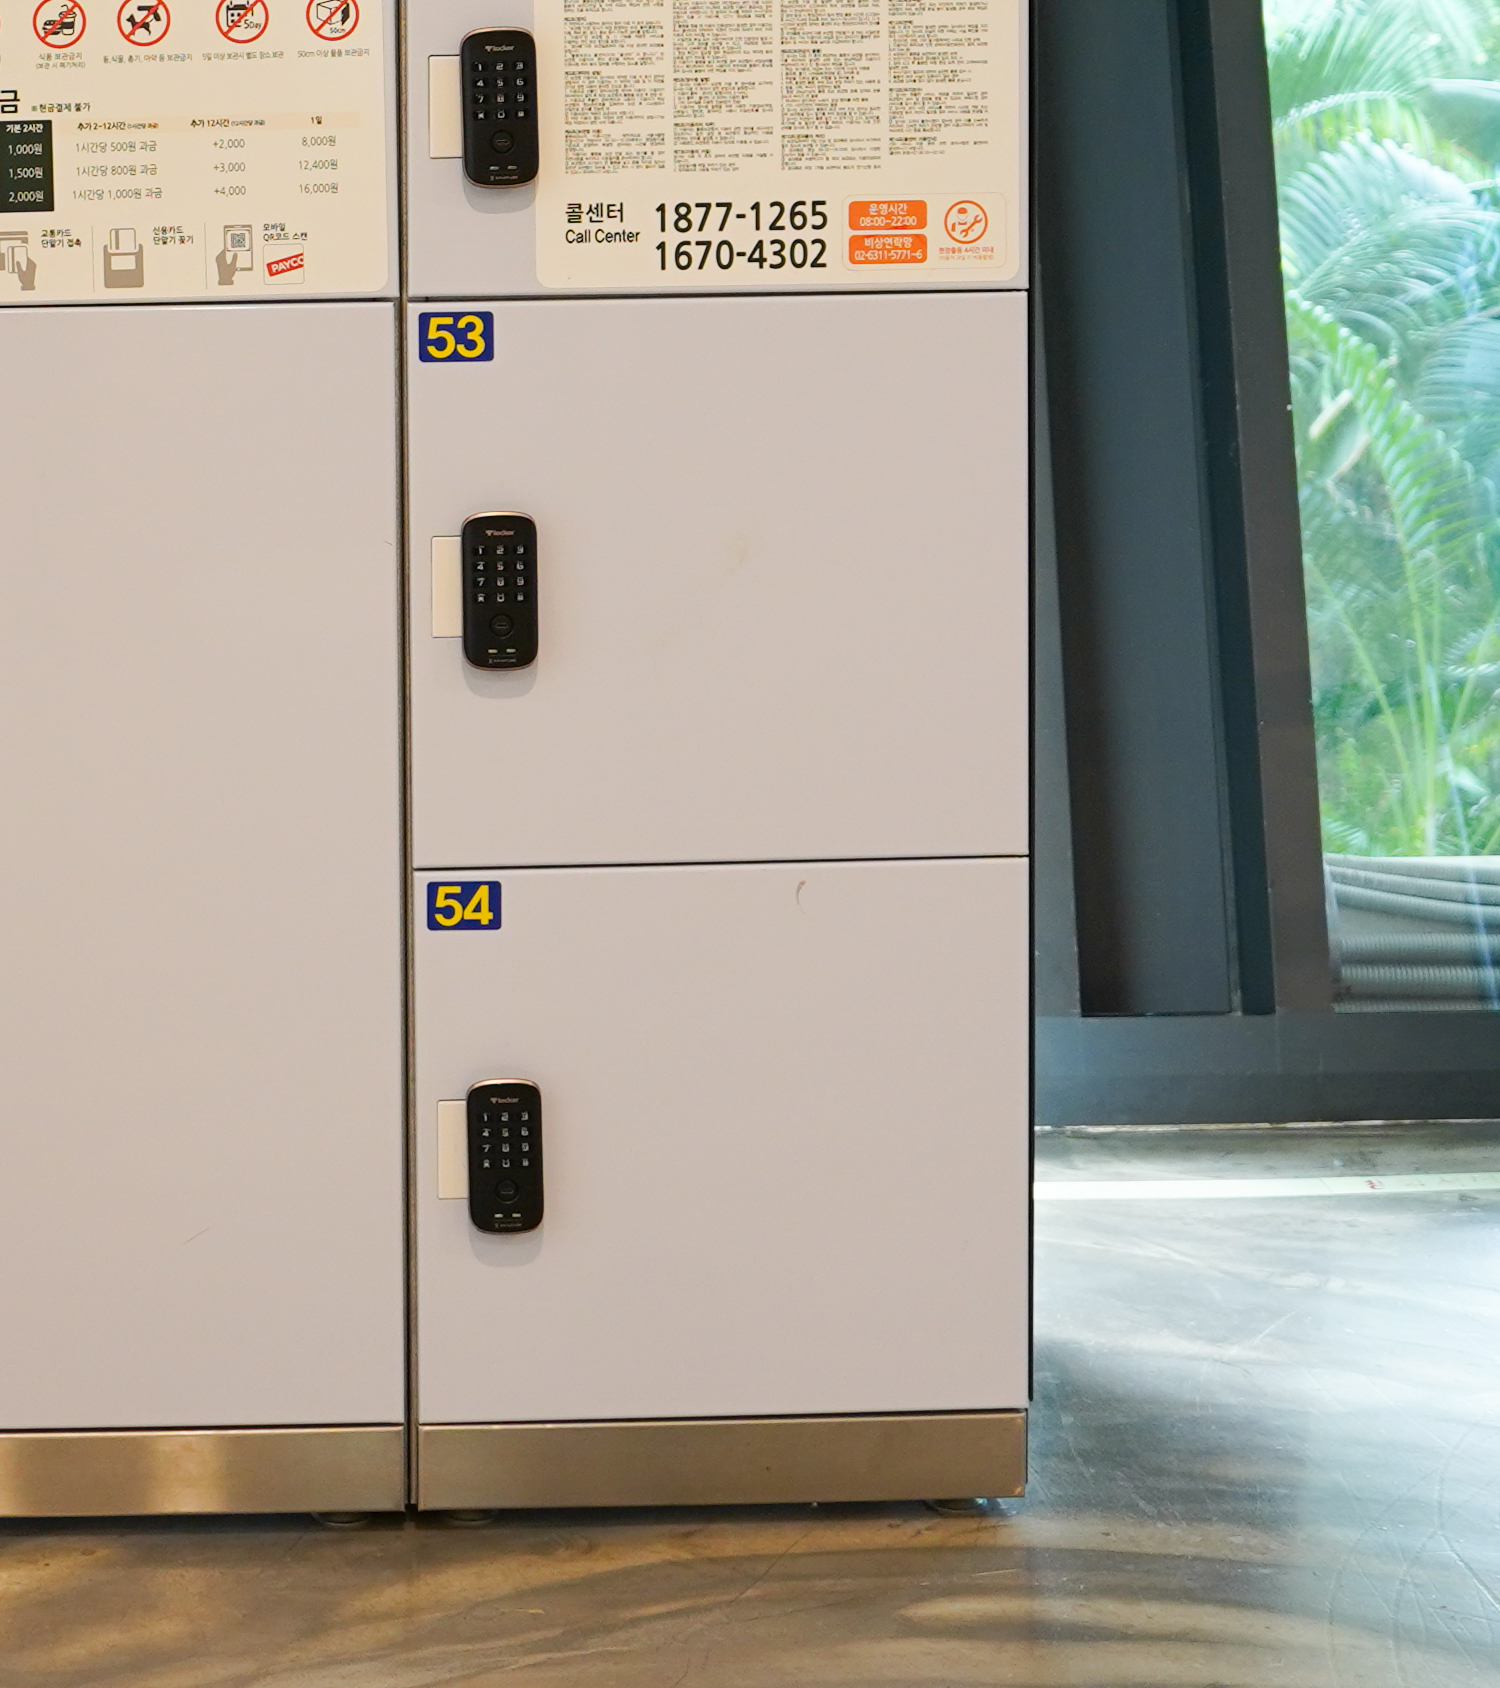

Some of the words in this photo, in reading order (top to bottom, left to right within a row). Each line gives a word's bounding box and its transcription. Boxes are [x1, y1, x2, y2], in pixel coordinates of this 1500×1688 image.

[213, 139, 245, 149] +2,000
[301, 135, 336, 147] 8,000원
[8, 143, 43, 156] 1,000원
[869, 203, 907, 214] 운영시간
[565, 203, 625, 223] 콜센터
[655, 200, 828, 234] 1877-1265
[565, 228, 591, 244] Call
[594, 228, 640, 244] Center
[864, 237, 913, 248] 비상연락망
[655, 239, 828, 271] 1670-4302
[426, 314, 486, 359] 53
[434, 884, 494, 927] 54
